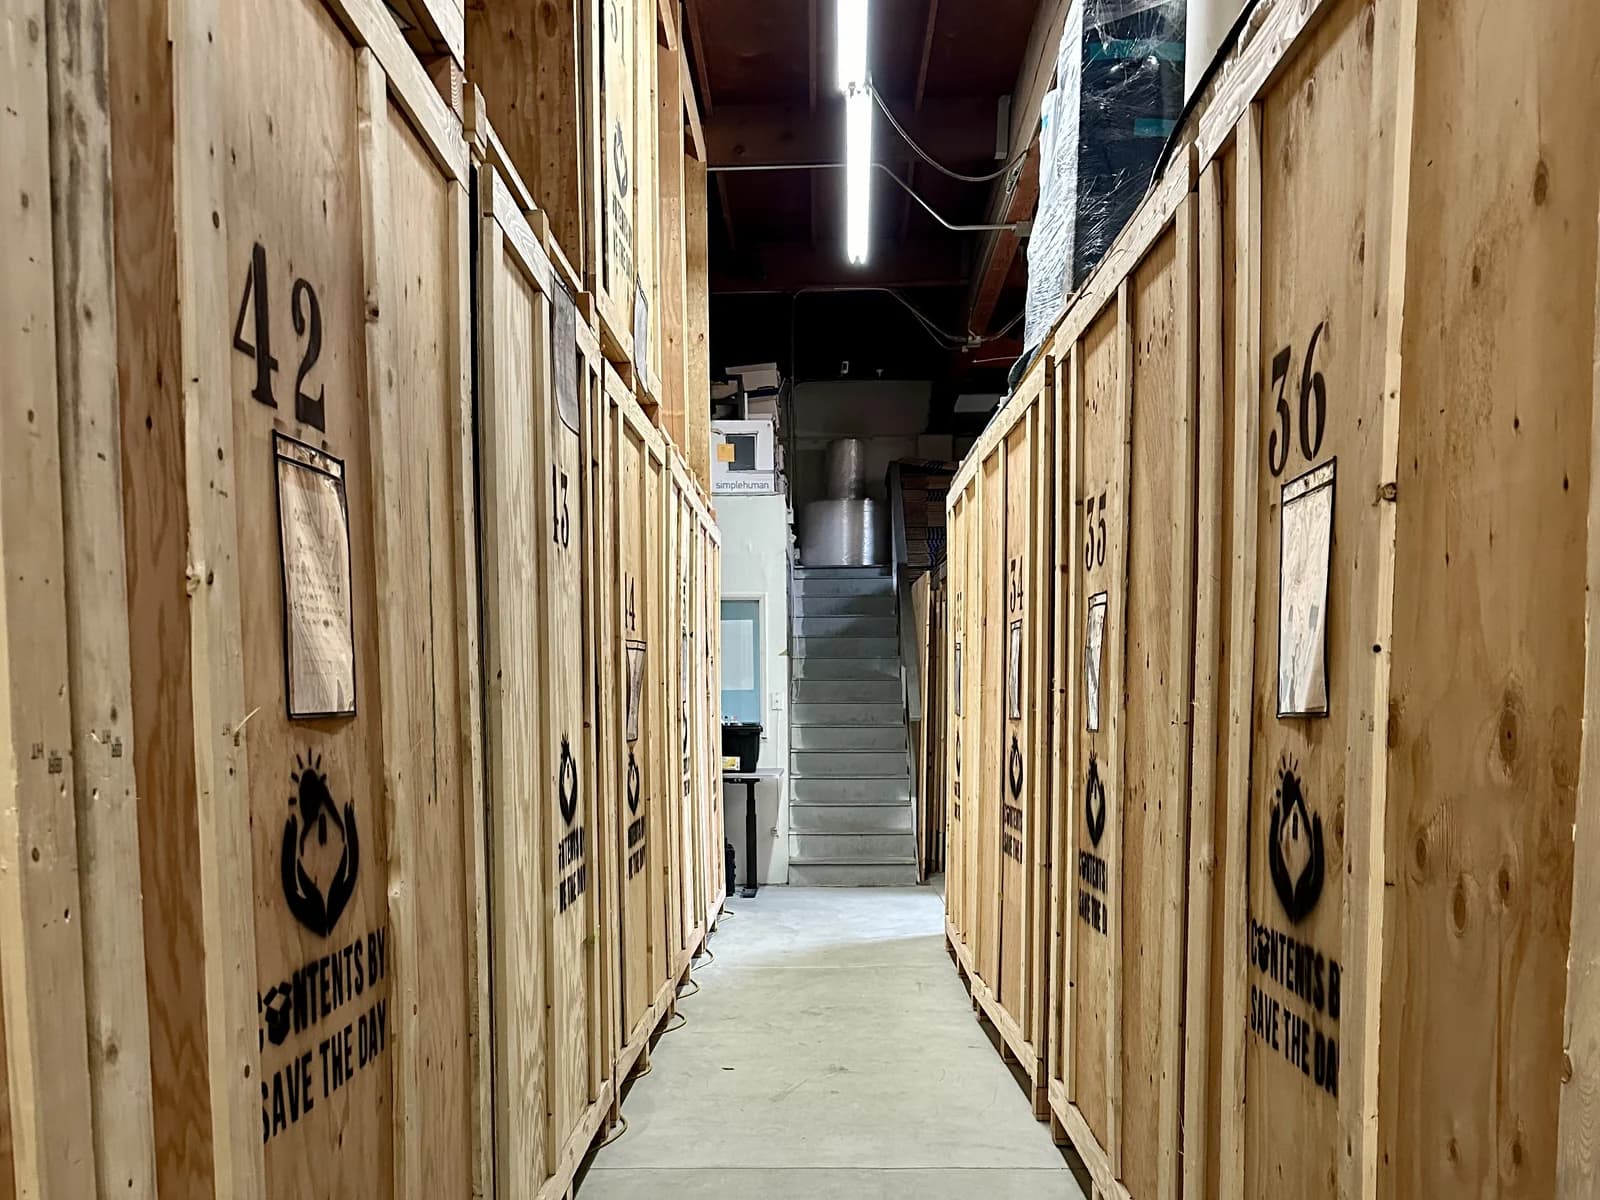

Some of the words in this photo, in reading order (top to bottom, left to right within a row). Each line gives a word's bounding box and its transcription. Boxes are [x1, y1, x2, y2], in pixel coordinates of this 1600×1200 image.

[233, 242, 326, 433] 42
[1269, 321, 1326, 477] 36
[716, 480, 769, 490] simplehuman
[1086, 488, 1106, 571] 35
[1010, 555, 1024, 613] 34
[367, 926, 386, 987] BY
[1251, 918, 1324, 1012] CONTENTS
[1328, 959, 1340, 1020] B
[319, 1023, 353, 1098] THE
[358, 998, 386, 1070] DAY
[1250, 984, 1280, 1051] SAVE
[1284, 1008, 1310, 1078] THE
[1314, 1031, 1338, 1099] DA
